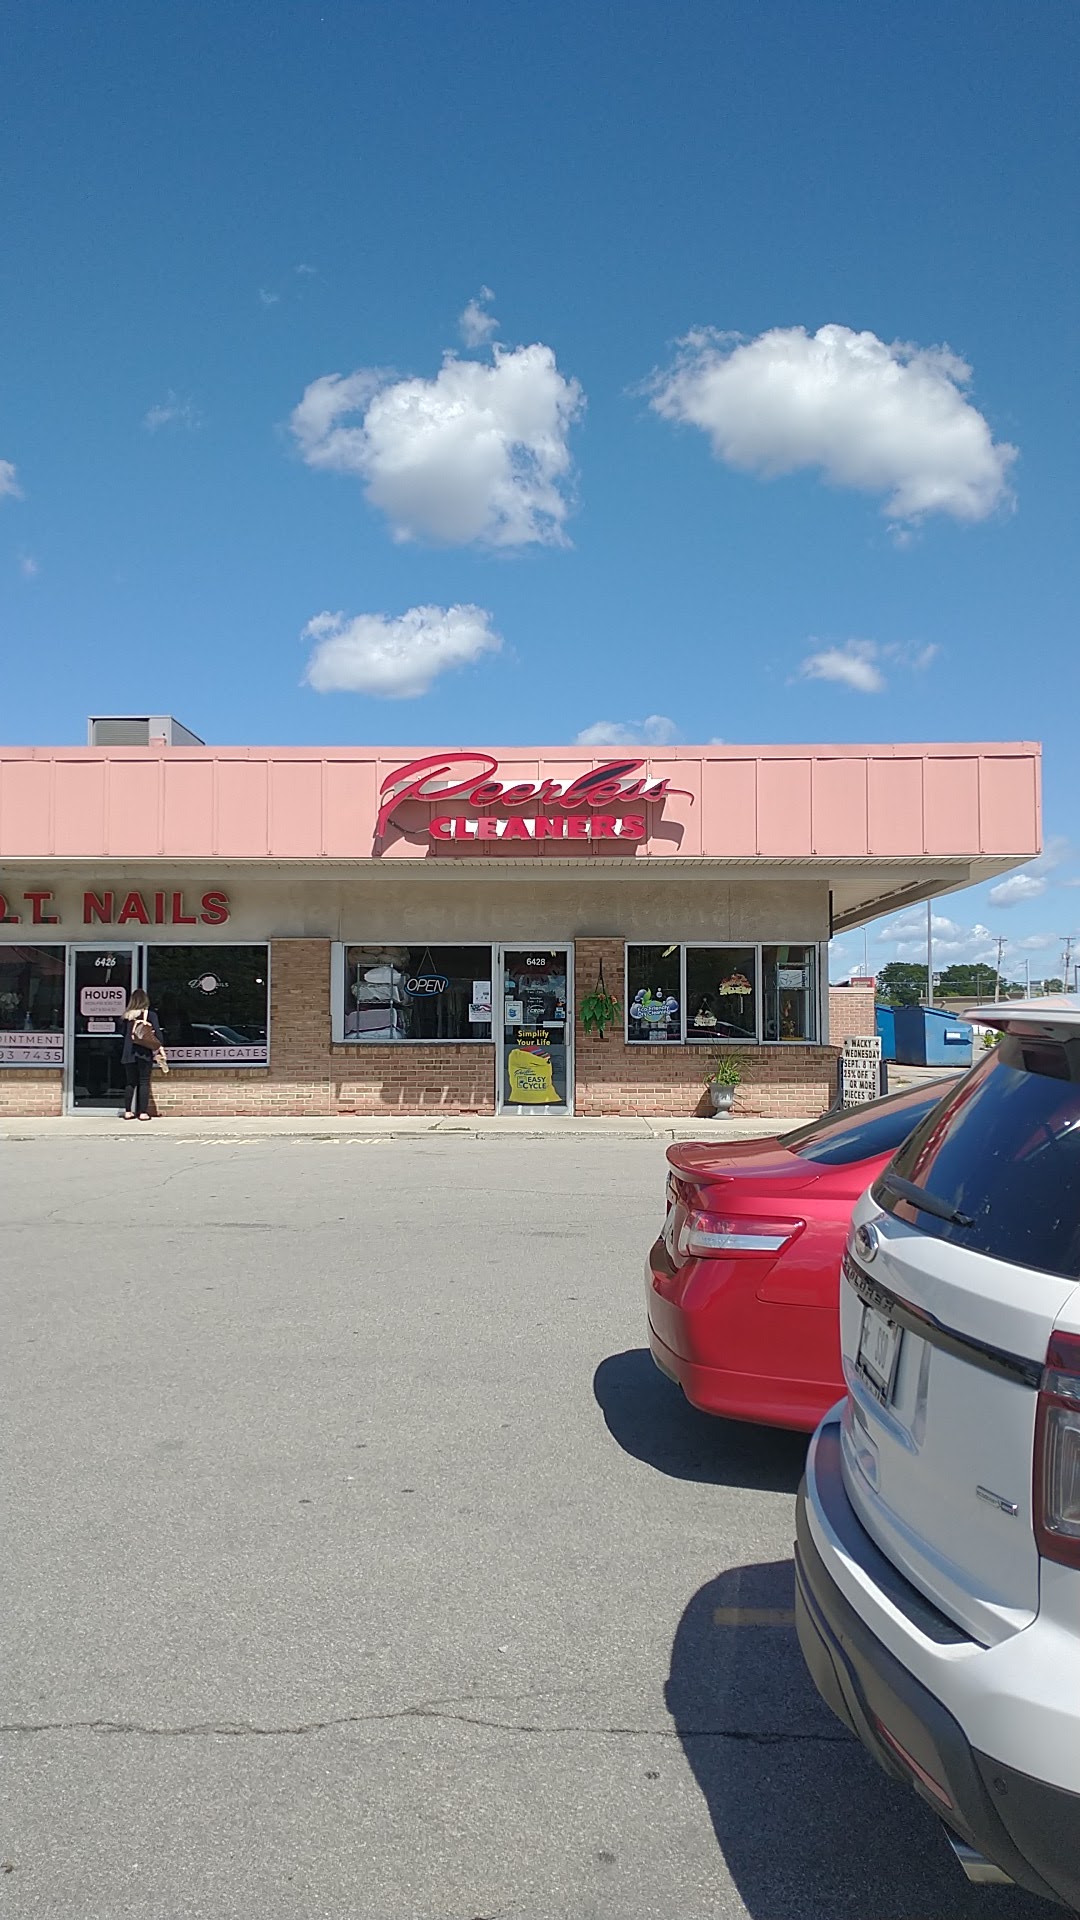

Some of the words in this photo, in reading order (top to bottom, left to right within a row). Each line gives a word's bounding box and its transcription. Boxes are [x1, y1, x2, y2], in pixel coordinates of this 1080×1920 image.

[378, 752, 694, 838] Peerless
[429, 815, 646, 840] CLEANERS
[83, 891, 231, 926] NAILS
[95, 957, 116, 967] 6426
[526, 958, 546, 966] 6428
[406, 978, 446, 993] OPEN
[84, 990, 123, 1000] HOURS
[517, 1030, 550, 1039] Simplify
[23, 1051, 61, 1061] 7435
[845, 1050, 880, 1058] WEDNESDAY
[844, 1059, 861, 1068] SEPT.
[863, 1060, 866, 1068] 8
[869, 1061, 876, 1069] TH
[844, 1070, 856, 1078] 25%
[857, 1071, 868, 1079] OFF
[850, 1080, 857, 1088] OR
[859, 1081, 876, 1090] MORE
[845, 1090, 865, 1099] PIECES
[868, 1092, 876, 1100] OF
